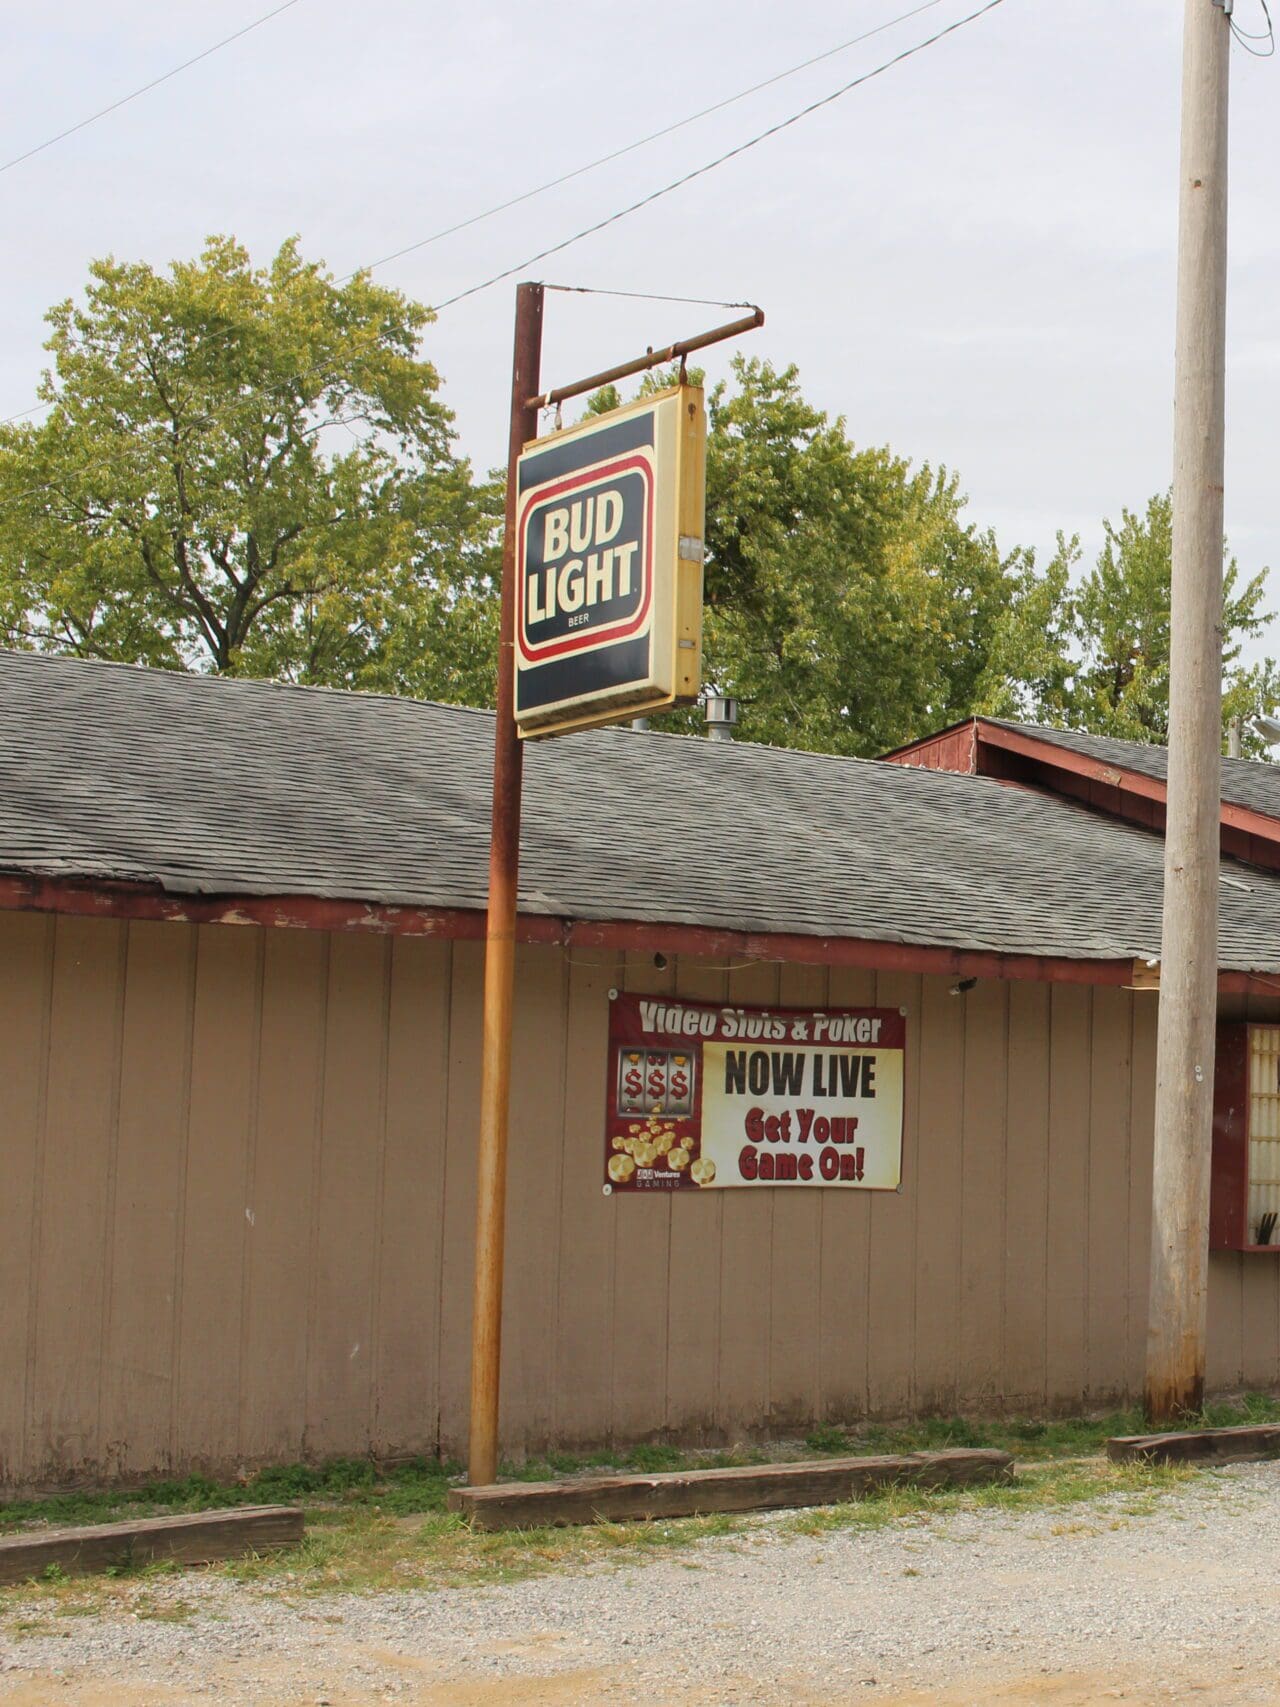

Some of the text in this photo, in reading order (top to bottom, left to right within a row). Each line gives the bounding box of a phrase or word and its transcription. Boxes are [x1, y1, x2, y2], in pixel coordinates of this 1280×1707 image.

[543, 490, 623, 563] BUD
[528, 541, 638, 625] LIGHT
[568, 613, 589, 627] BEER
[639, 1001, 882, 1043] Video Slots & Poker
[725, 1050, 876, 1098] NOW LIVE
[745, 1107, 858, 1144] Get Your
[654, 1169, 680, 1178] Ventures
[738, 1145, 865, 1182] Game On!
[636, 1180, 680, 1188] GAMING
